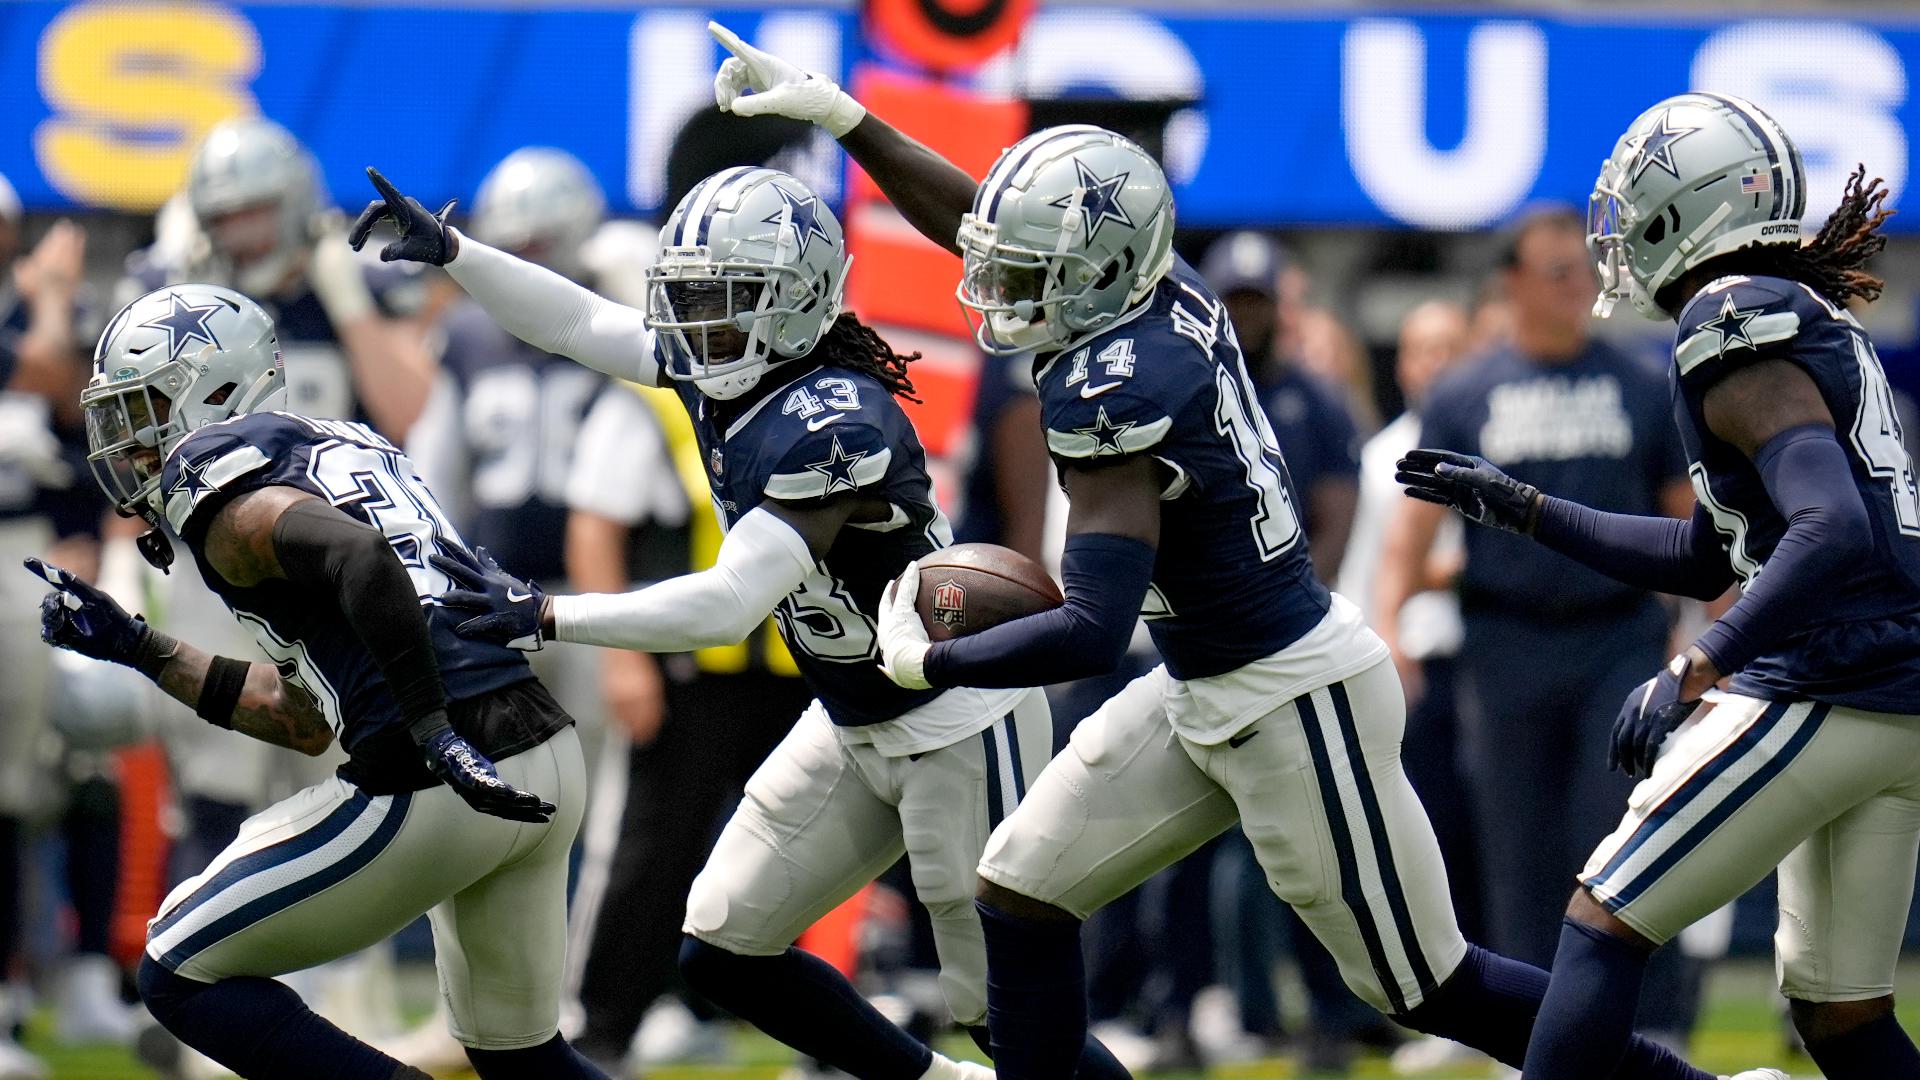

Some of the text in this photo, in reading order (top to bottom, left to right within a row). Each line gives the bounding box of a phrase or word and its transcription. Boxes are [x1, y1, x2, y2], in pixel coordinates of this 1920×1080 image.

[35, 4, 263, 211] S
[1065, 338, 1137, 388] 14
[781, 377, 863, 421] 43
[937, 586, 963, 609] NFL
